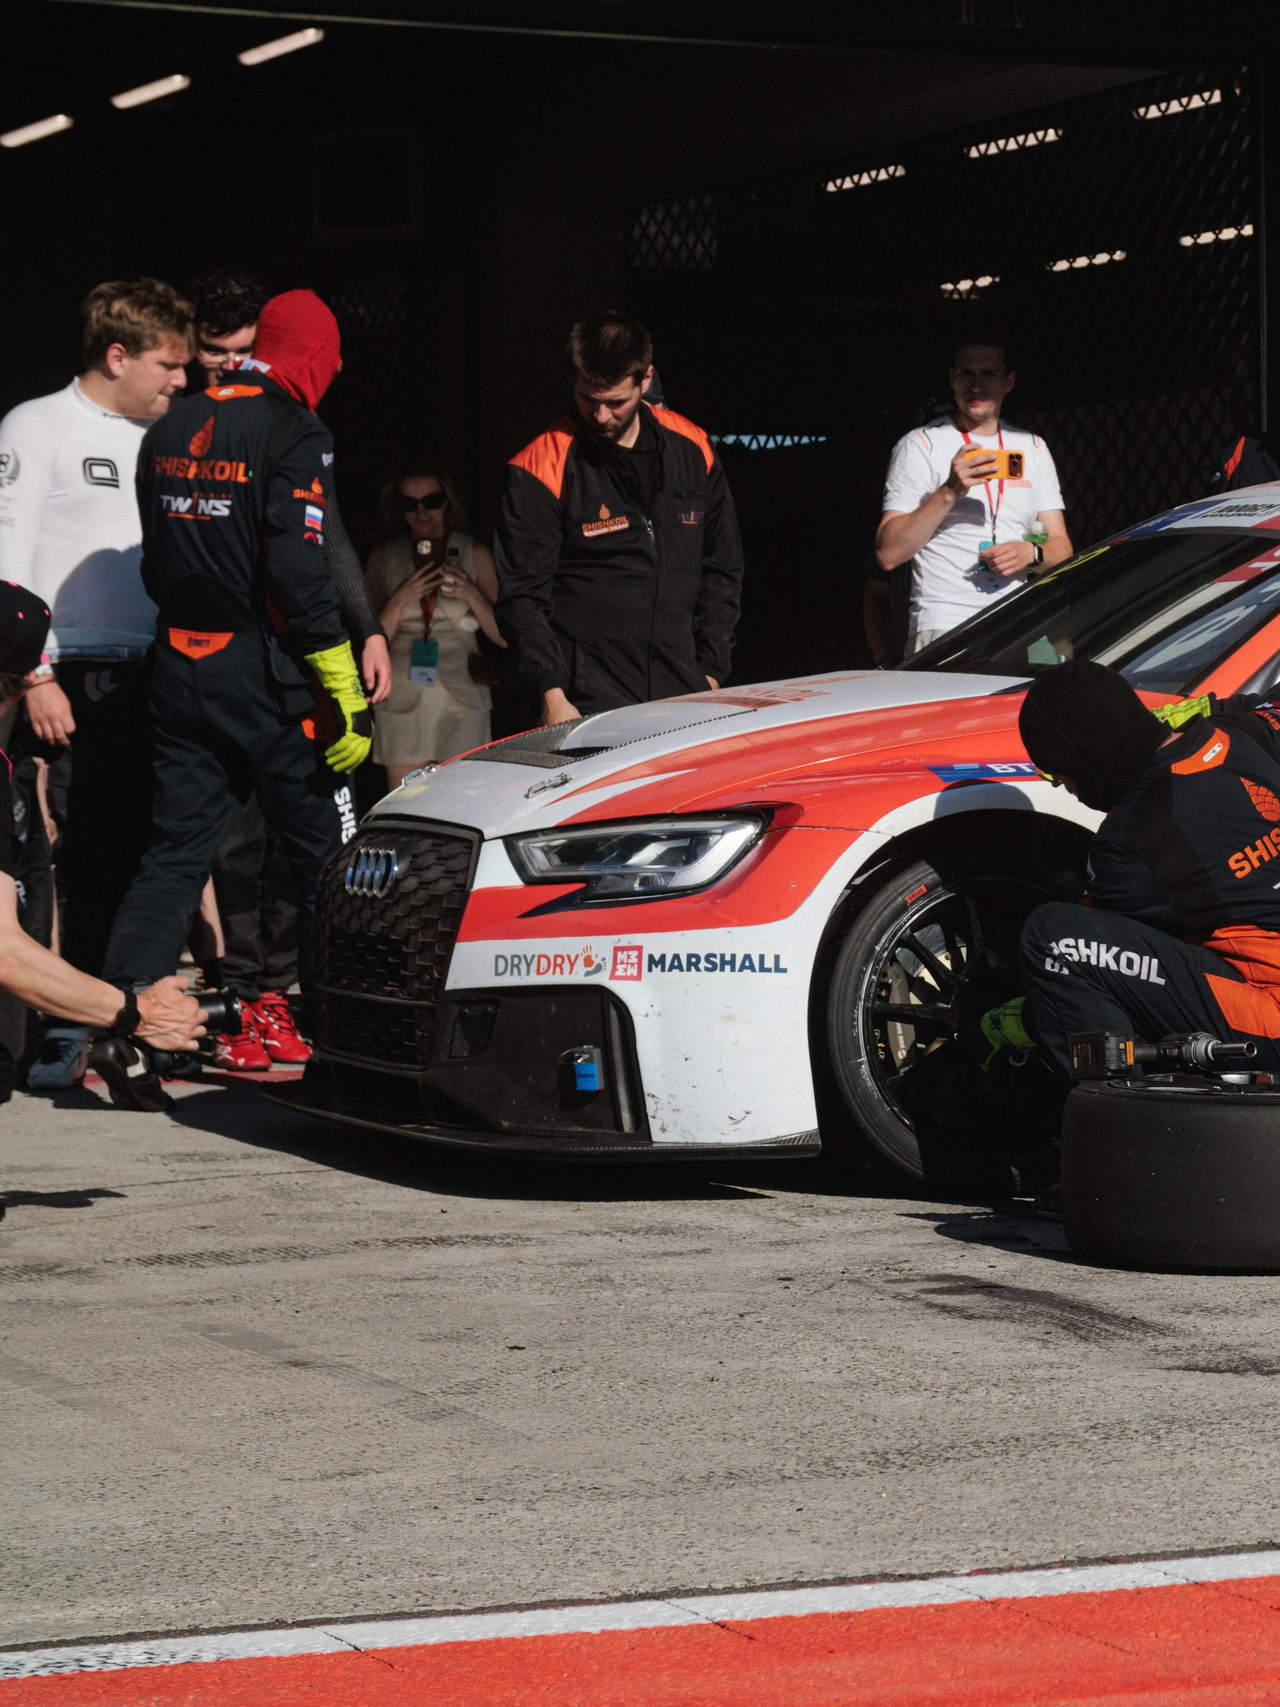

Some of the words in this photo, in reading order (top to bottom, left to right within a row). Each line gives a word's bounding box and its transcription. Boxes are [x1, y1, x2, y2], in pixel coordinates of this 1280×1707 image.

[985, 762, 1036, 774] ВТ
[494, 953, 579, 977] DRYDRY
[647, 953, 788, 974] MARSHALL
